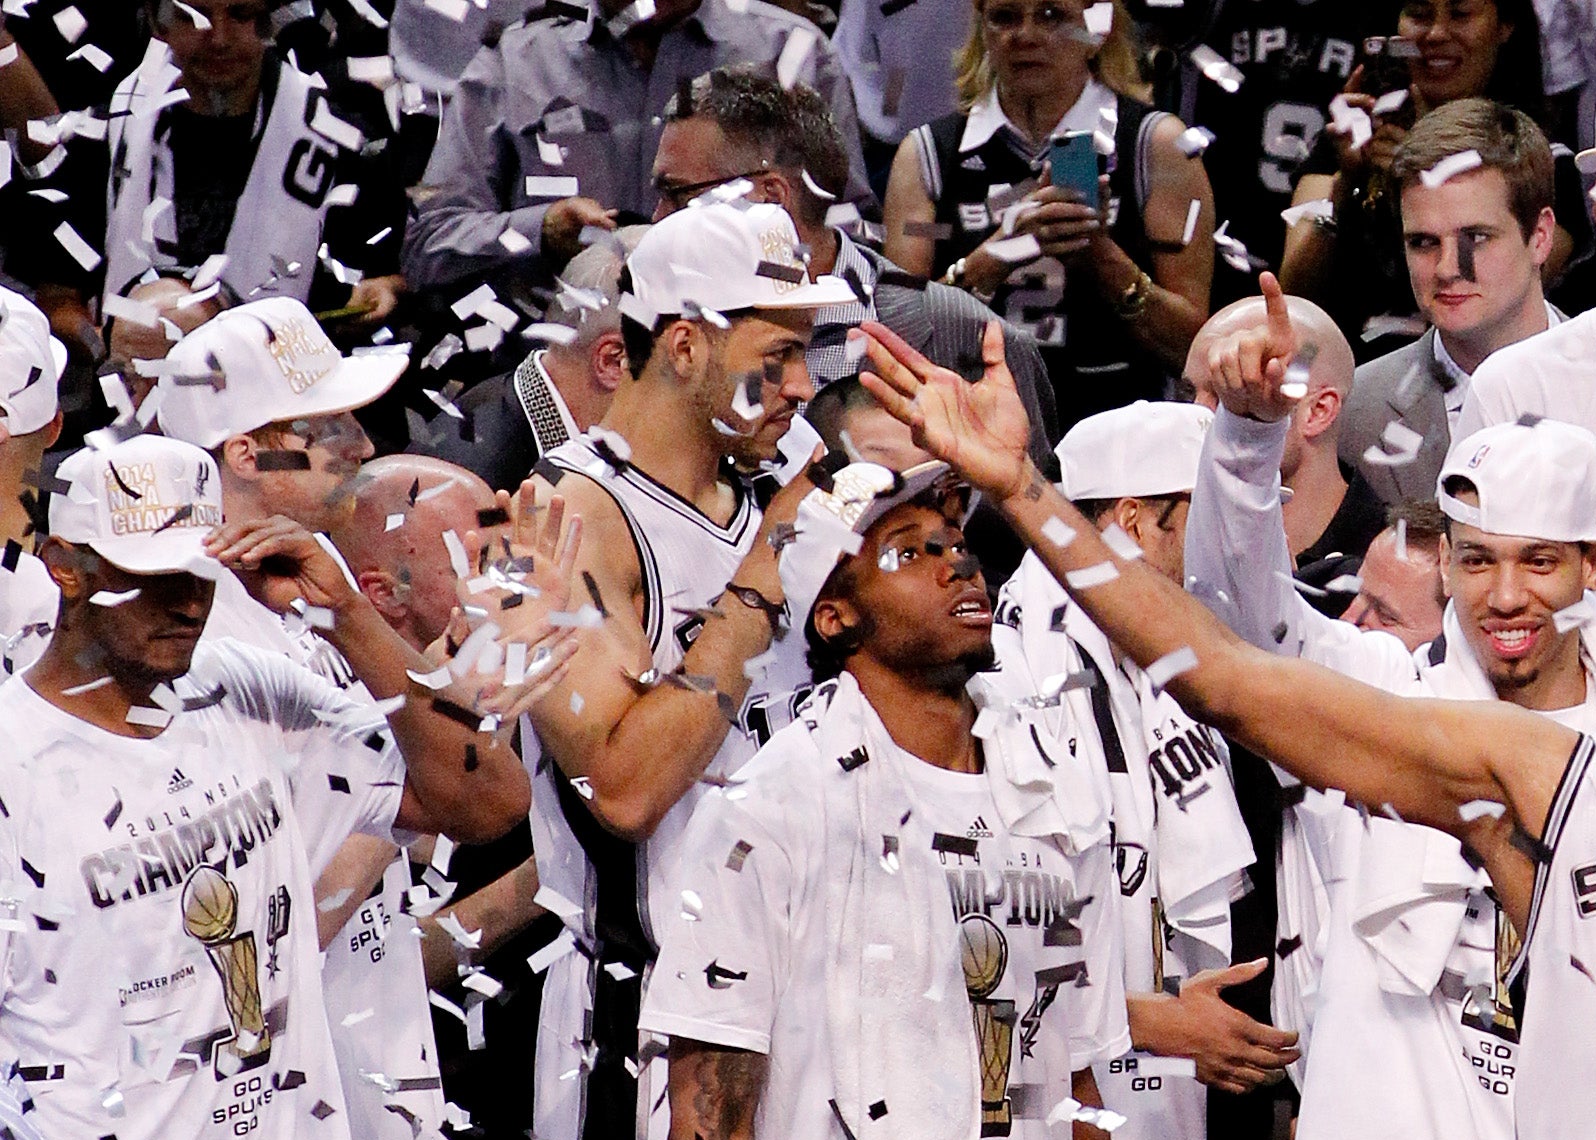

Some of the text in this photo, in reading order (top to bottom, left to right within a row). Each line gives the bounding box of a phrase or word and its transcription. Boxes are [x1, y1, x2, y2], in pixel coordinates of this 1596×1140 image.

[1153, 718, 1181, 741] BA
[126, 805, 194, 838] 2014
[939, 849, 981, 866] 014
[1462, 1046, 1517, 1080] PUR
[233, 1076, 262, 1098] GO
[1130, 1076, 1163, 1092] GO
[1477, 1075, 1510, 1096] GO
[233, 1114, 259, 1137] GO
